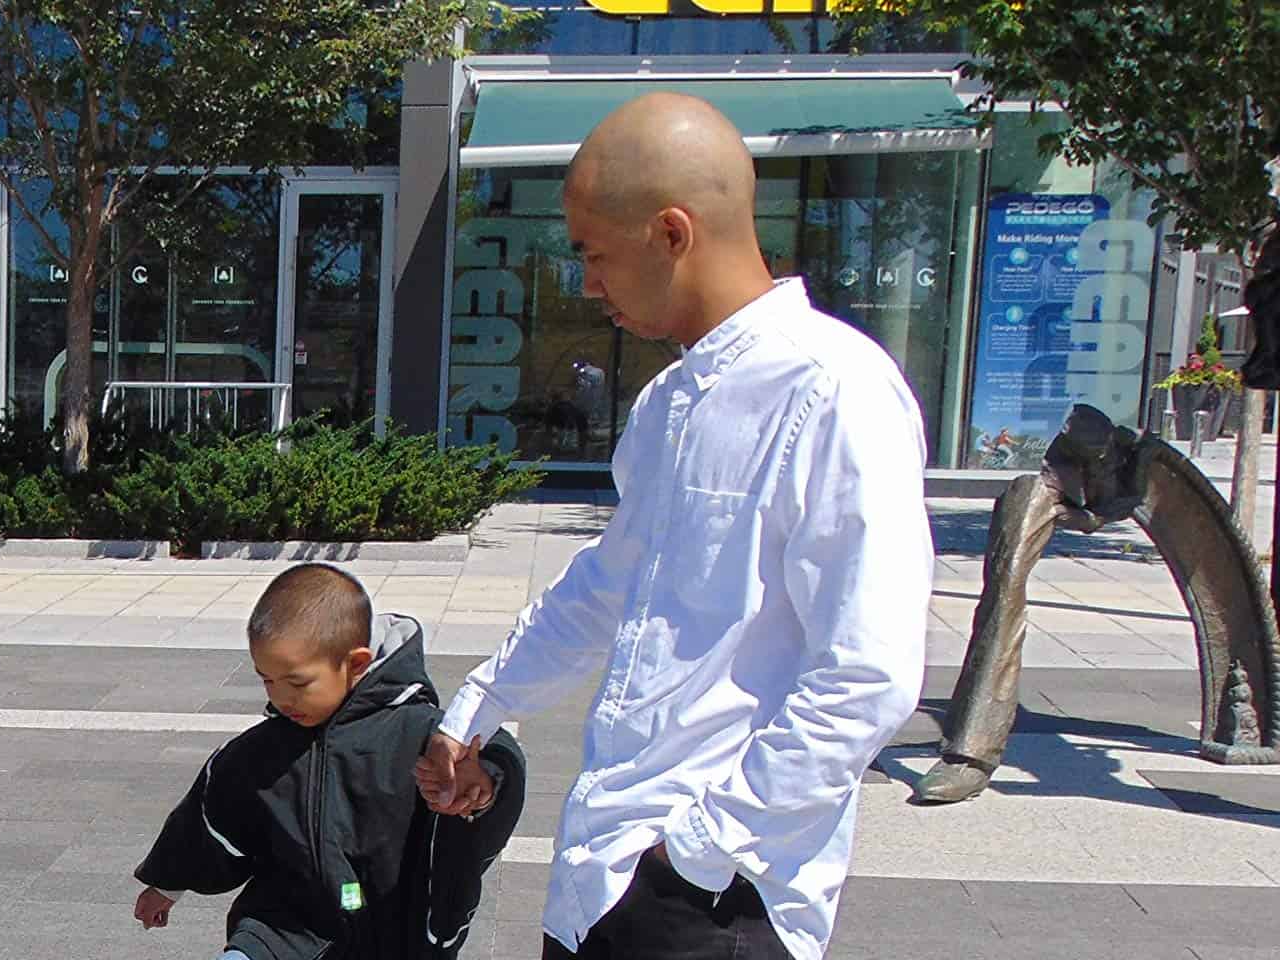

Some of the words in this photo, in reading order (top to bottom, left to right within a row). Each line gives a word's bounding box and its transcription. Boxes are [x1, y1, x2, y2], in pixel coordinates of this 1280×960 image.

[1005, 202, 1095, 215] PEDEGO
[997, 234, 1023, 243] Make
[1024, 233, 1053, 245] Riding
[1066, 219, 1157, 424] GEAR
